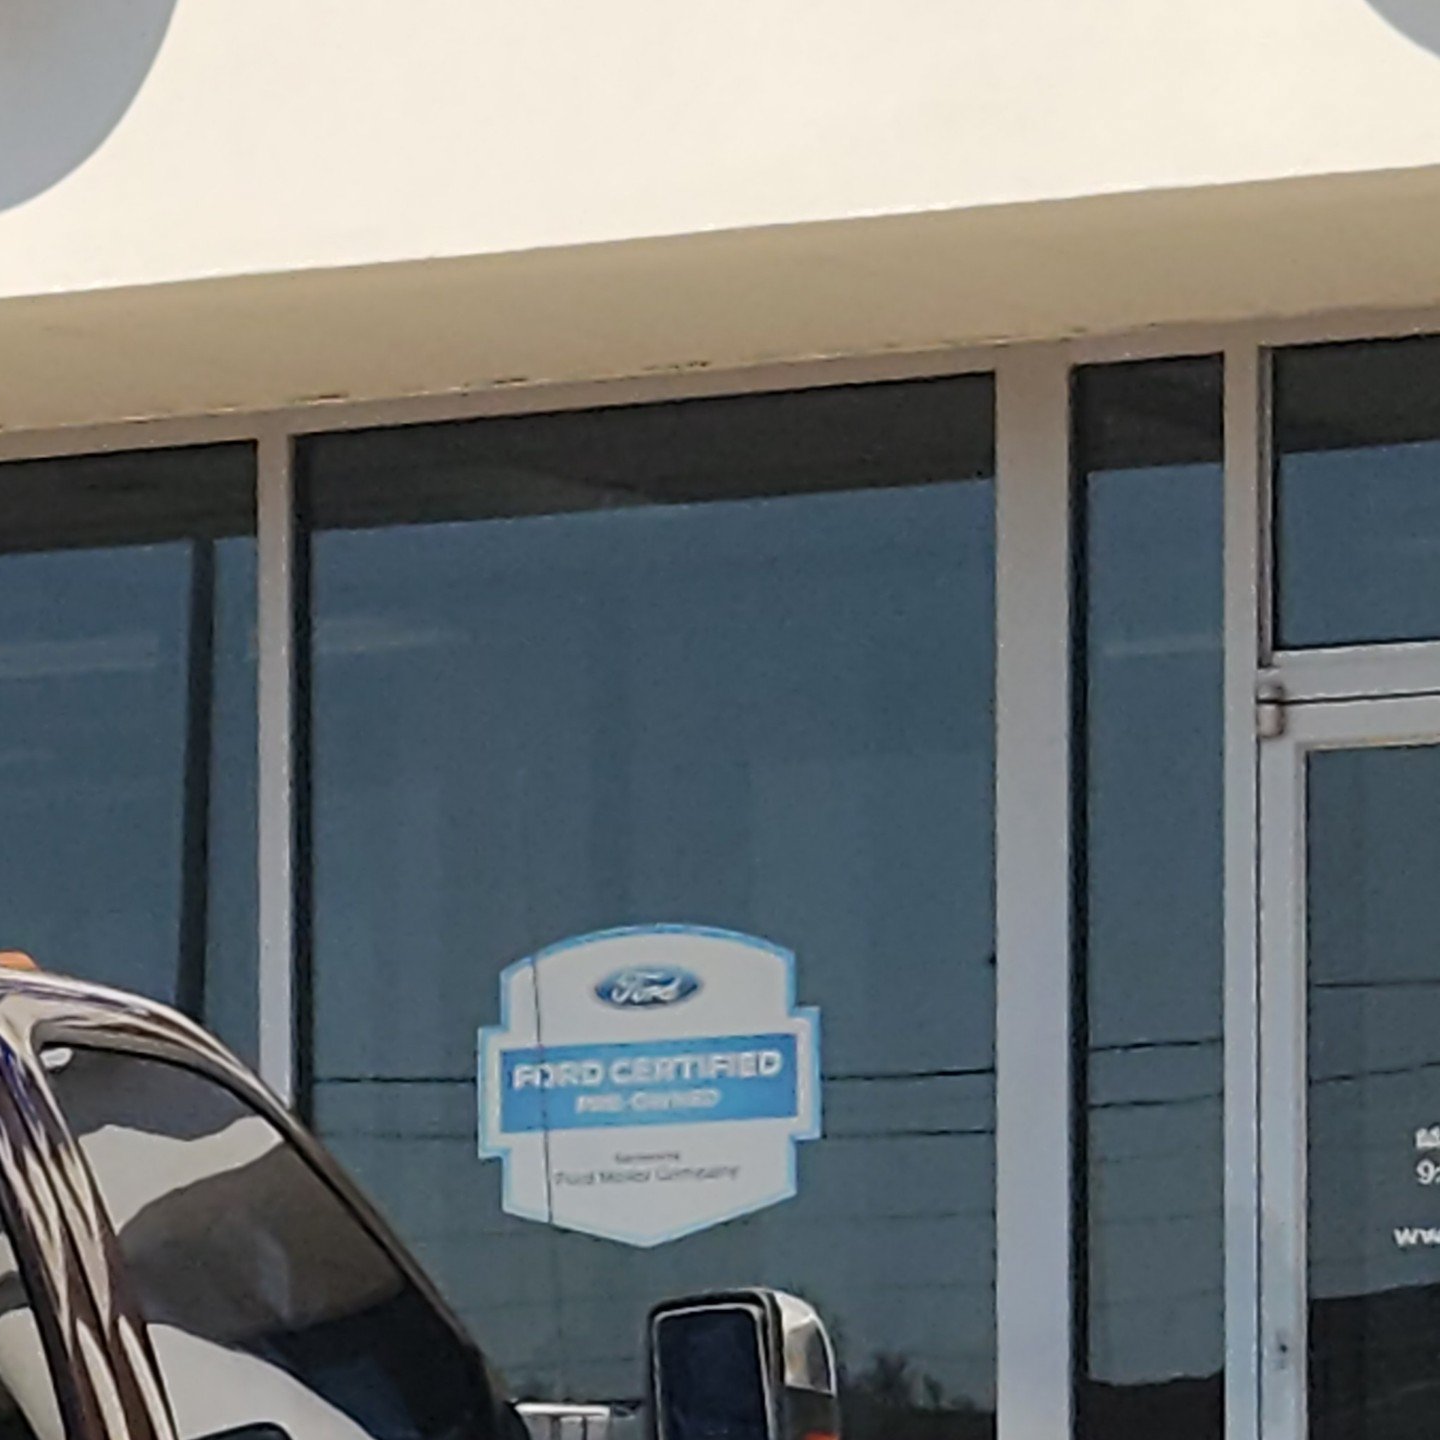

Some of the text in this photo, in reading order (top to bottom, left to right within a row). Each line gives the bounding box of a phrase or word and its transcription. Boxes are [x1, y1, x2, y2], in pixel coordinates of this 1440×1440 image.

[611, 971, 681, 1004] Ford
[513, 1050, 781, 1090] FORD CERTIFIED
